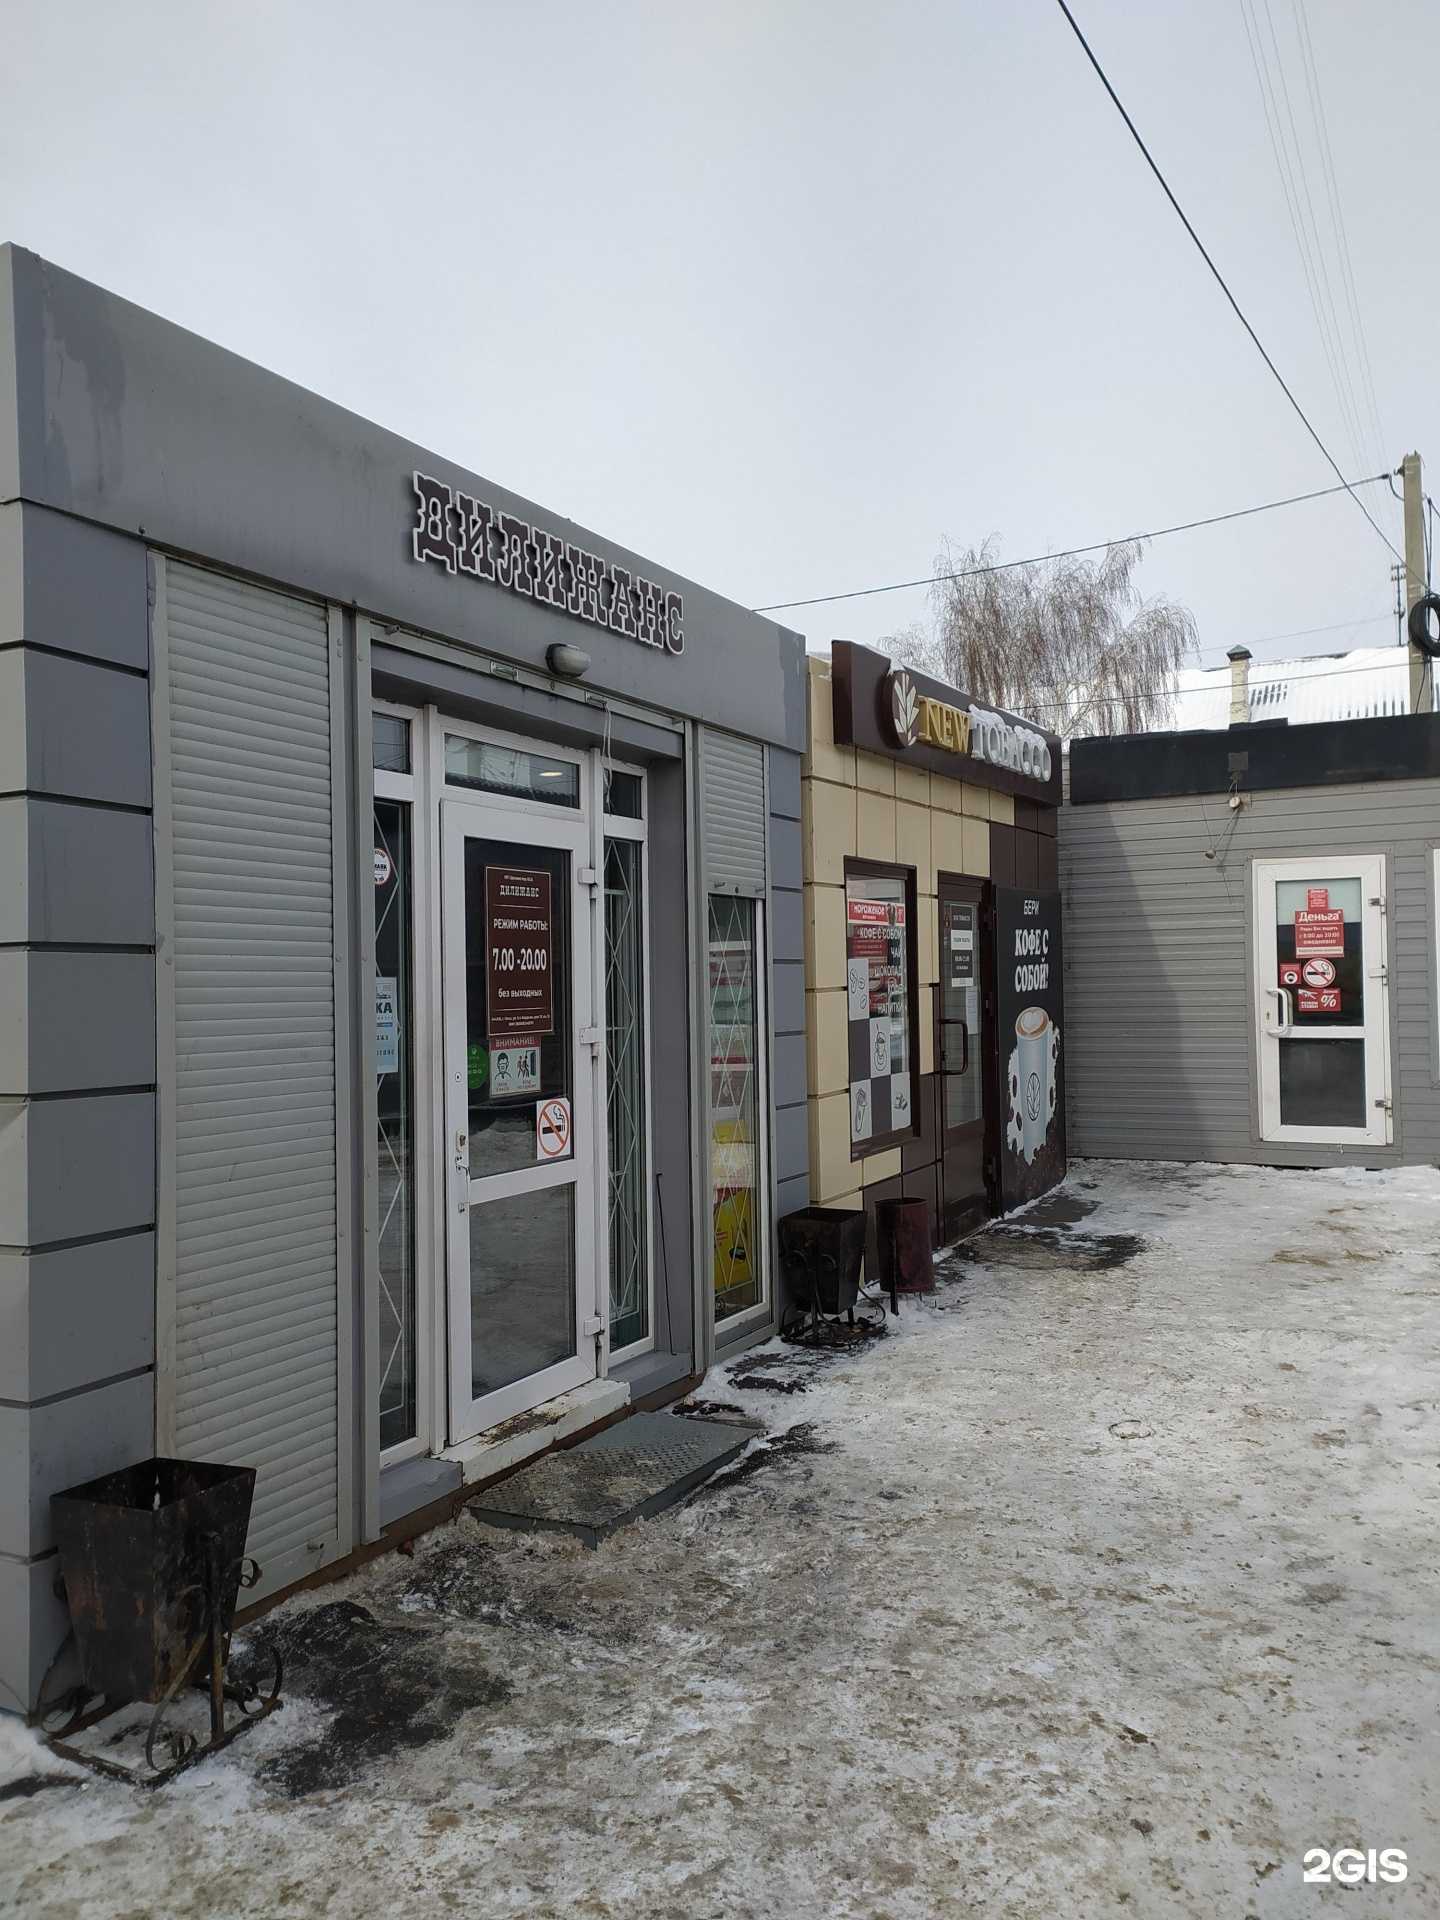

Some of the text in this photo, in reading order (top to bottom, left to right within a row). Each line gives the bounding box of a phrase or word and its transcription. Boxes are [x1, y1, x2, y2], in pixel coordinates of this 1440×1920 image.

[413, 470, 684, 655] ДИЛИЖАНС
[917, 695, 971, 754] NEW
[499, 884, 540, 898] ДИЛИЖАНС
[1023, 900, 1040, 915] БЕРИ
[493, 918, 549, 931] РЕЖИМ РАБОТЫ:
[1298, 911, 1340, 923] Деньга
[1015, 929, 1049, 956] КОФЕ С
[493, 948, 515, 971] 7.00
[498, 987, 542, 998] без выходных
